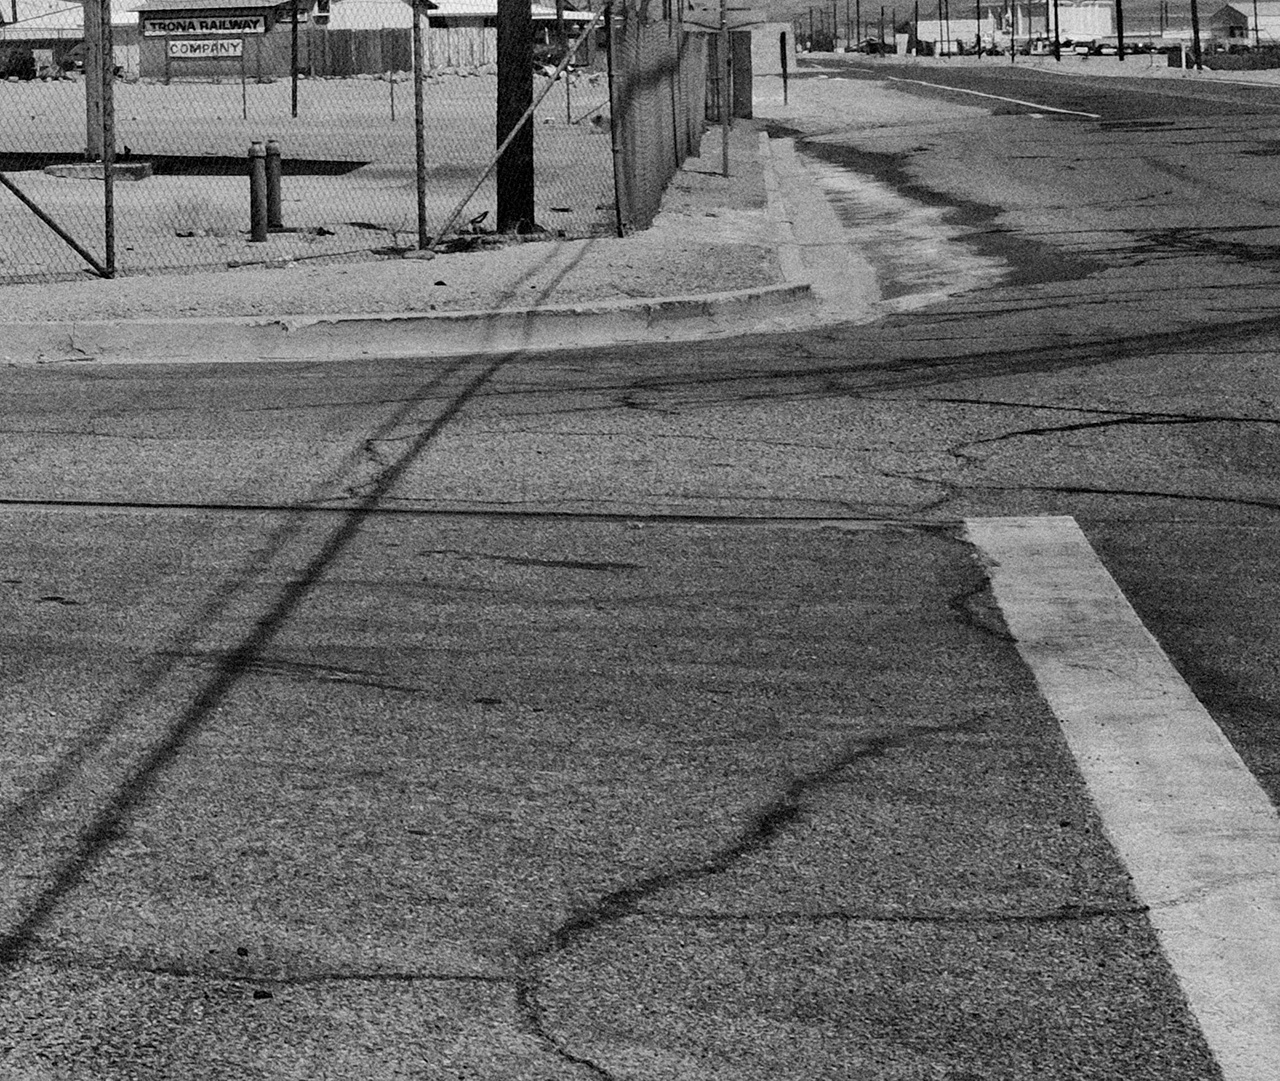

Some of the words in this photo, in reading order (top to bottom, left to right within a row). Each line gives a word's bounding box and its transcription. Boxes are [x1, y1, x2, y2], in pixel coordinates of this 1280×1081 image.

[150, 21, 196, 31] TRONA
[200, 20, 260, 30] RAILWAY
[170, 42, 240, 54] COMPANY
